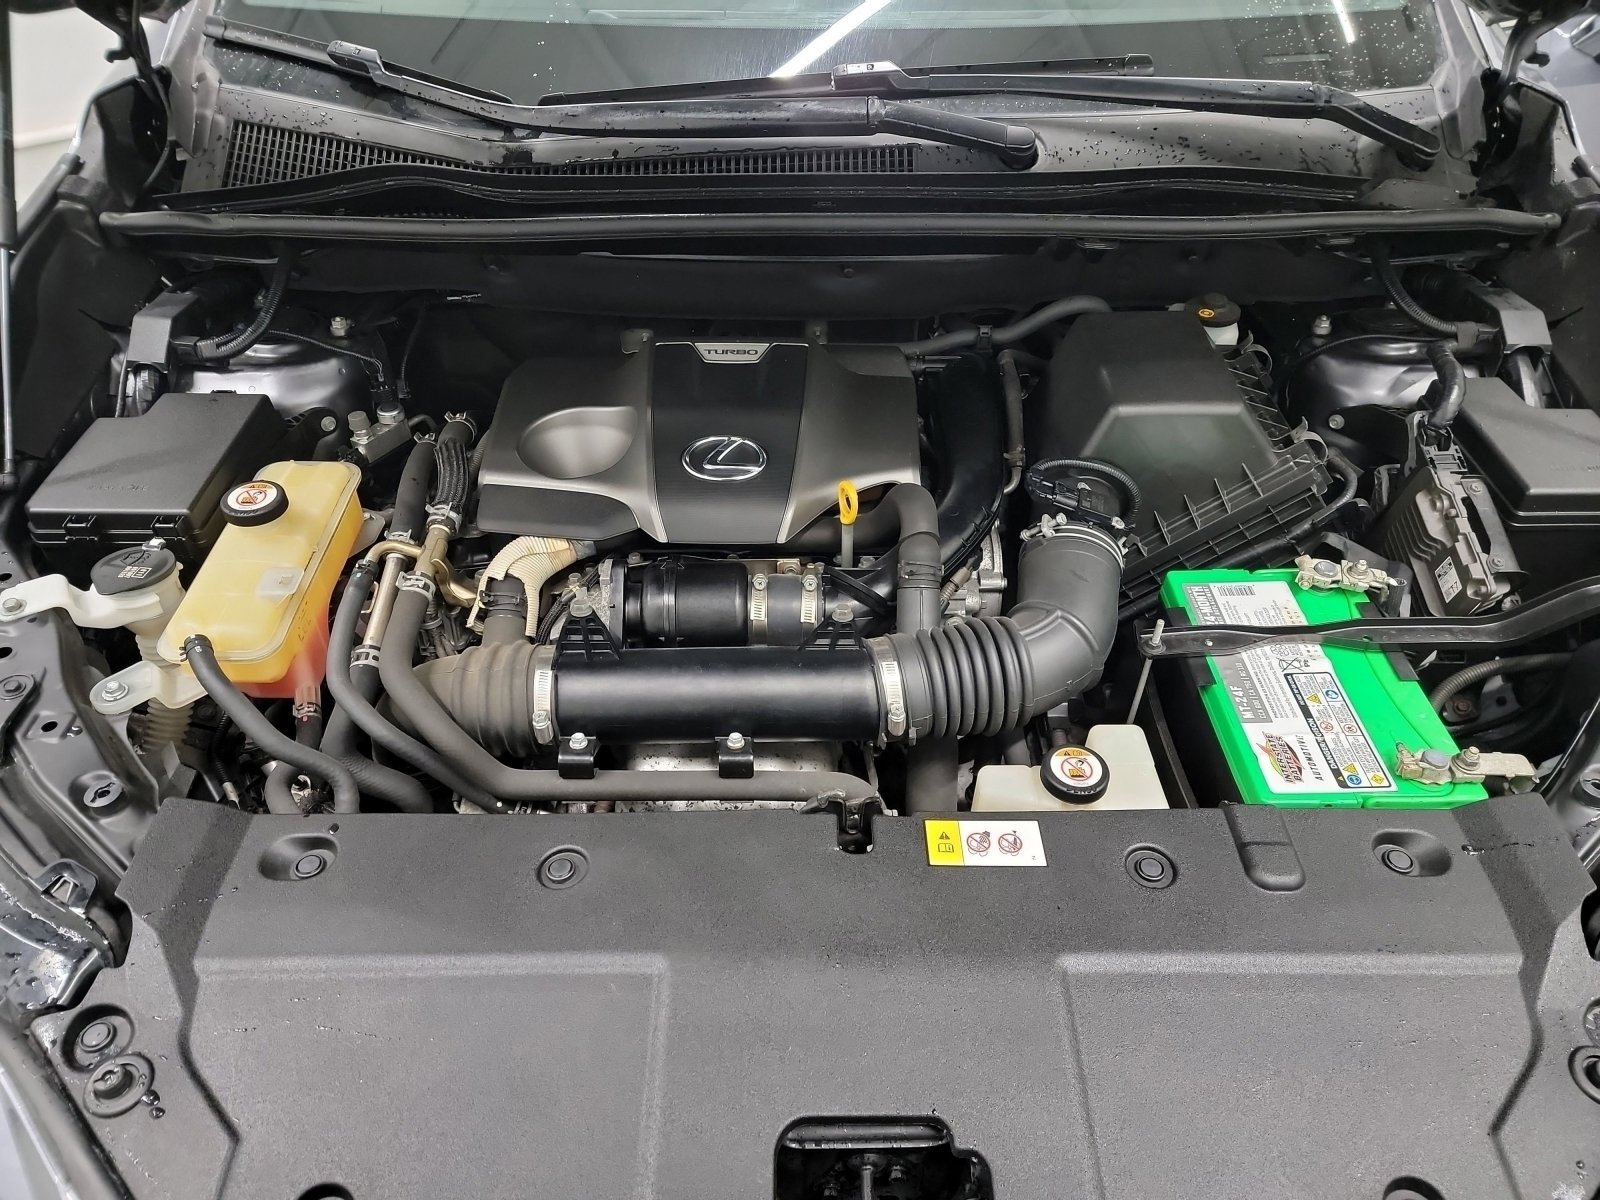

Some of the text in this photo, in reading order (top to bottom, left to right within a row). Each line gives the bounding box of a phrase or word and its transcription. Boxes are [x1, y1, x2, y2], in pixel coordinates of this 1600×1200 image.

[1229, 685, 1254, 718] MT-24F
[1256, 709, 1266, 718] CCA
[1264, 734, 1293, 782] INTERSTATE
[1275, 736, 1302, 781] BATTERIES
[1294, 735, 1323, 780] AUTOMOTIVE
